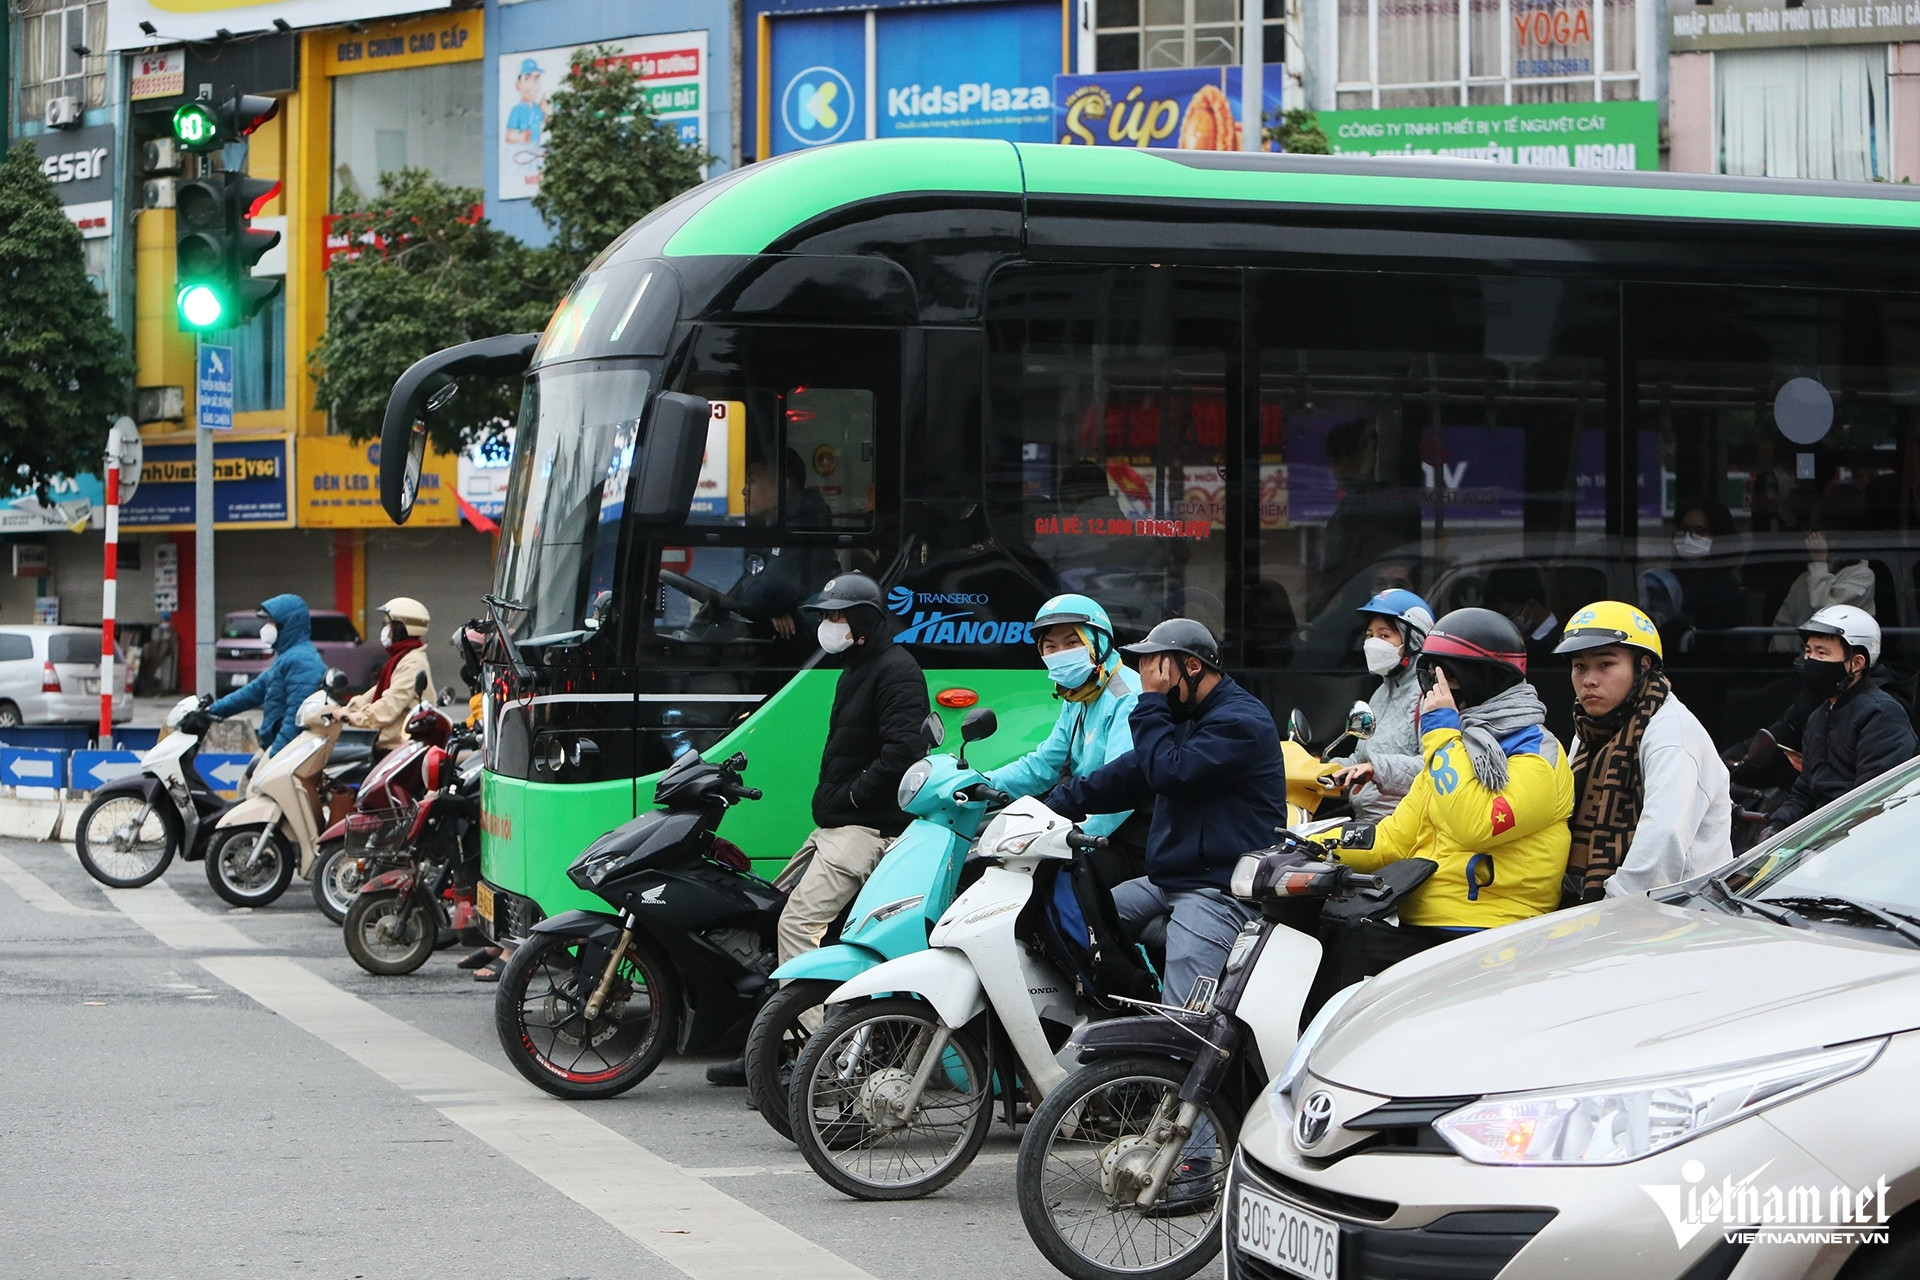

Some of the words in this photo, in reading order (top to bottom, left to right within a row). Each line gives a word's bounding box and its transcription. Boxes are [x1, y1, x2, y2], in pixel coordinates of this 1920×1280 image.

[1514, 9, 1590, 46] YOGA
[409, 32, 436, 53] CAO
[888, 83, 1050, 117] KidsPlaza
[1338, 121, 1384, 139] CÔNG
[1387, 123, 1404, 137] TY
[1491, 121, 1501, 133] Y
[345, 475, 369, 490] LED
[1035, 514, 1059, 535] GIÁ
[1088, 518, 1133, 536] 12.000
[917, 592, 989, 605] TRANSERCO
[1240, 1196, 1335, 1280] 30G-200.76
